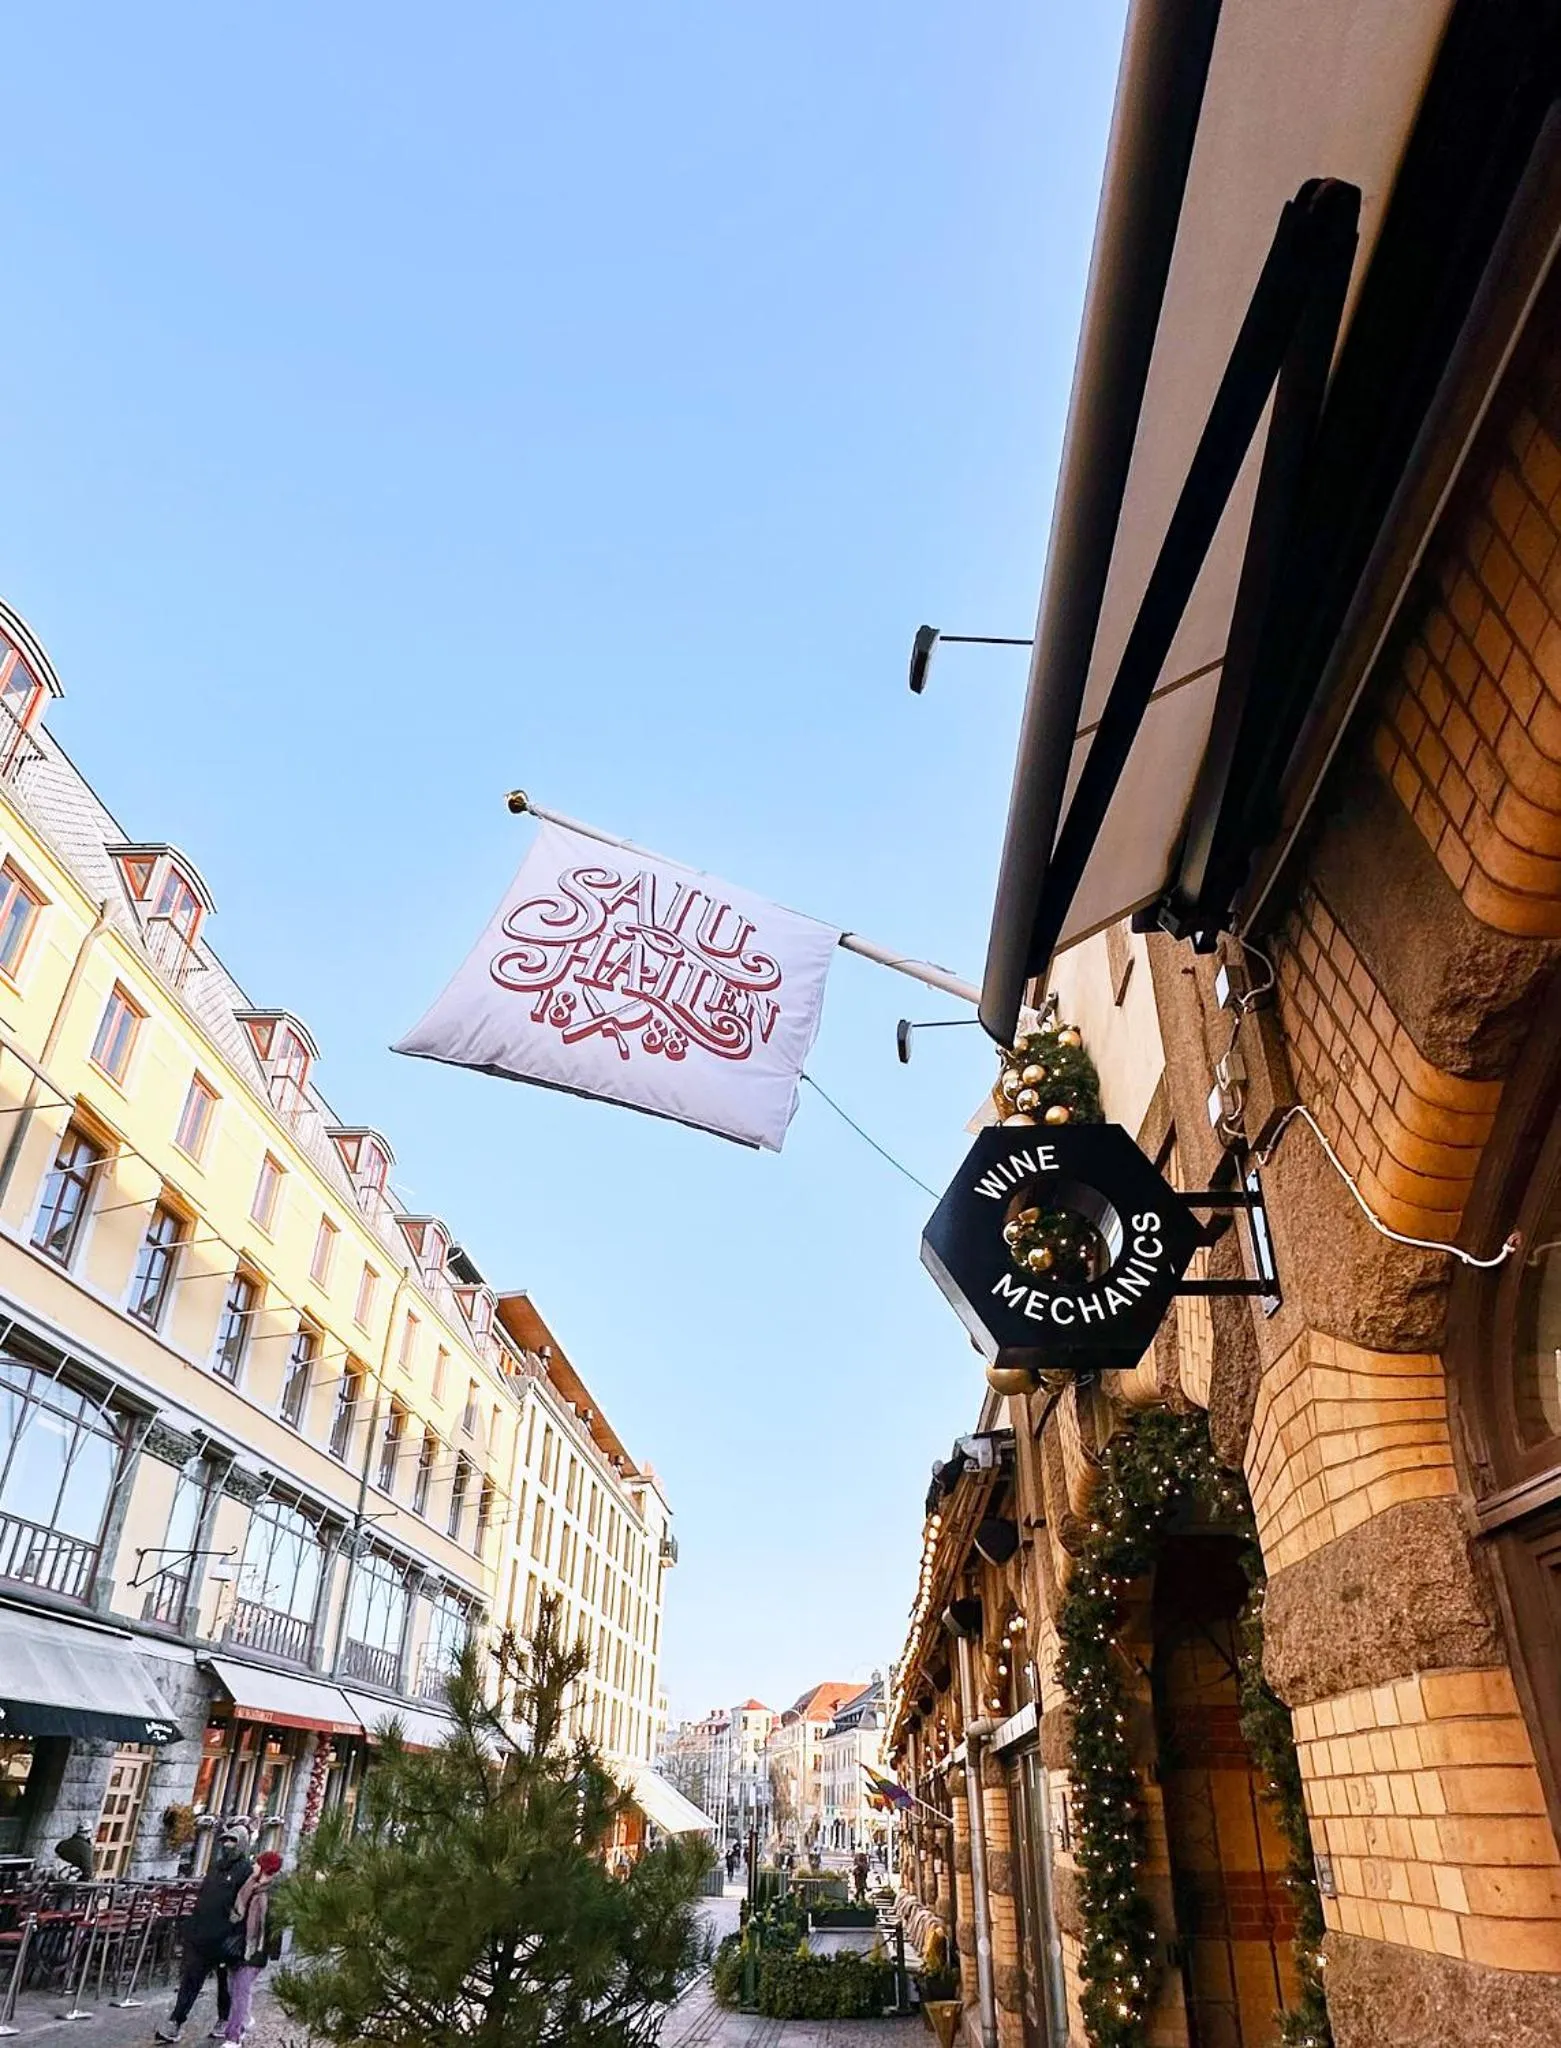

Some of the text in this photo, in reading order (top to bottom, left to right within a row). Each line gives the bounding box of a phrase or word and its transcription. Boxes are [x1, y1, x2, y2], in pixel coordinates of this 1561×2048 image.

[501, 866, 781, 990] SALU
[490, 933, 780, 1060] HALLEN
[974, 1145, 1060, 1200] WINE
[991, 1211, 1163, 1325] MECHANICS
